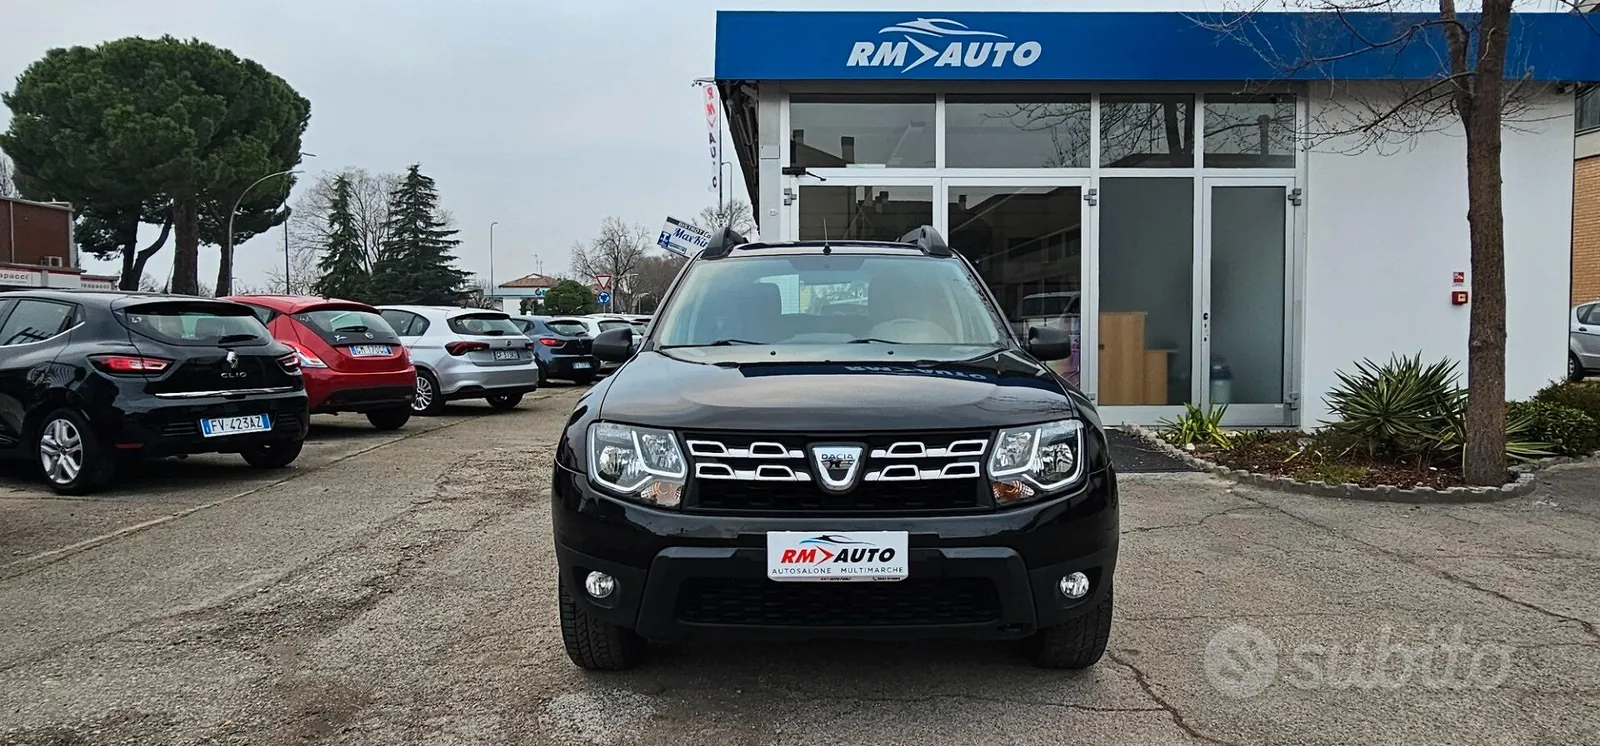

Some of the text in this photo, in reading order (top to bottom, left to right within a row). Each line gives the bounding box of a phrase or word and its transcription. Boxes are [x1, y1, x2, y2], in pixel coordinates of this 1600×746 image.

[846, 41, 1042, 68] RM AUTO
[220, 371, 248, 379] CLIO
[780, 547, 896, 564] RM AUTO
[772, 566, 904, 575] AUTOSALONE MULTIMARCHE
